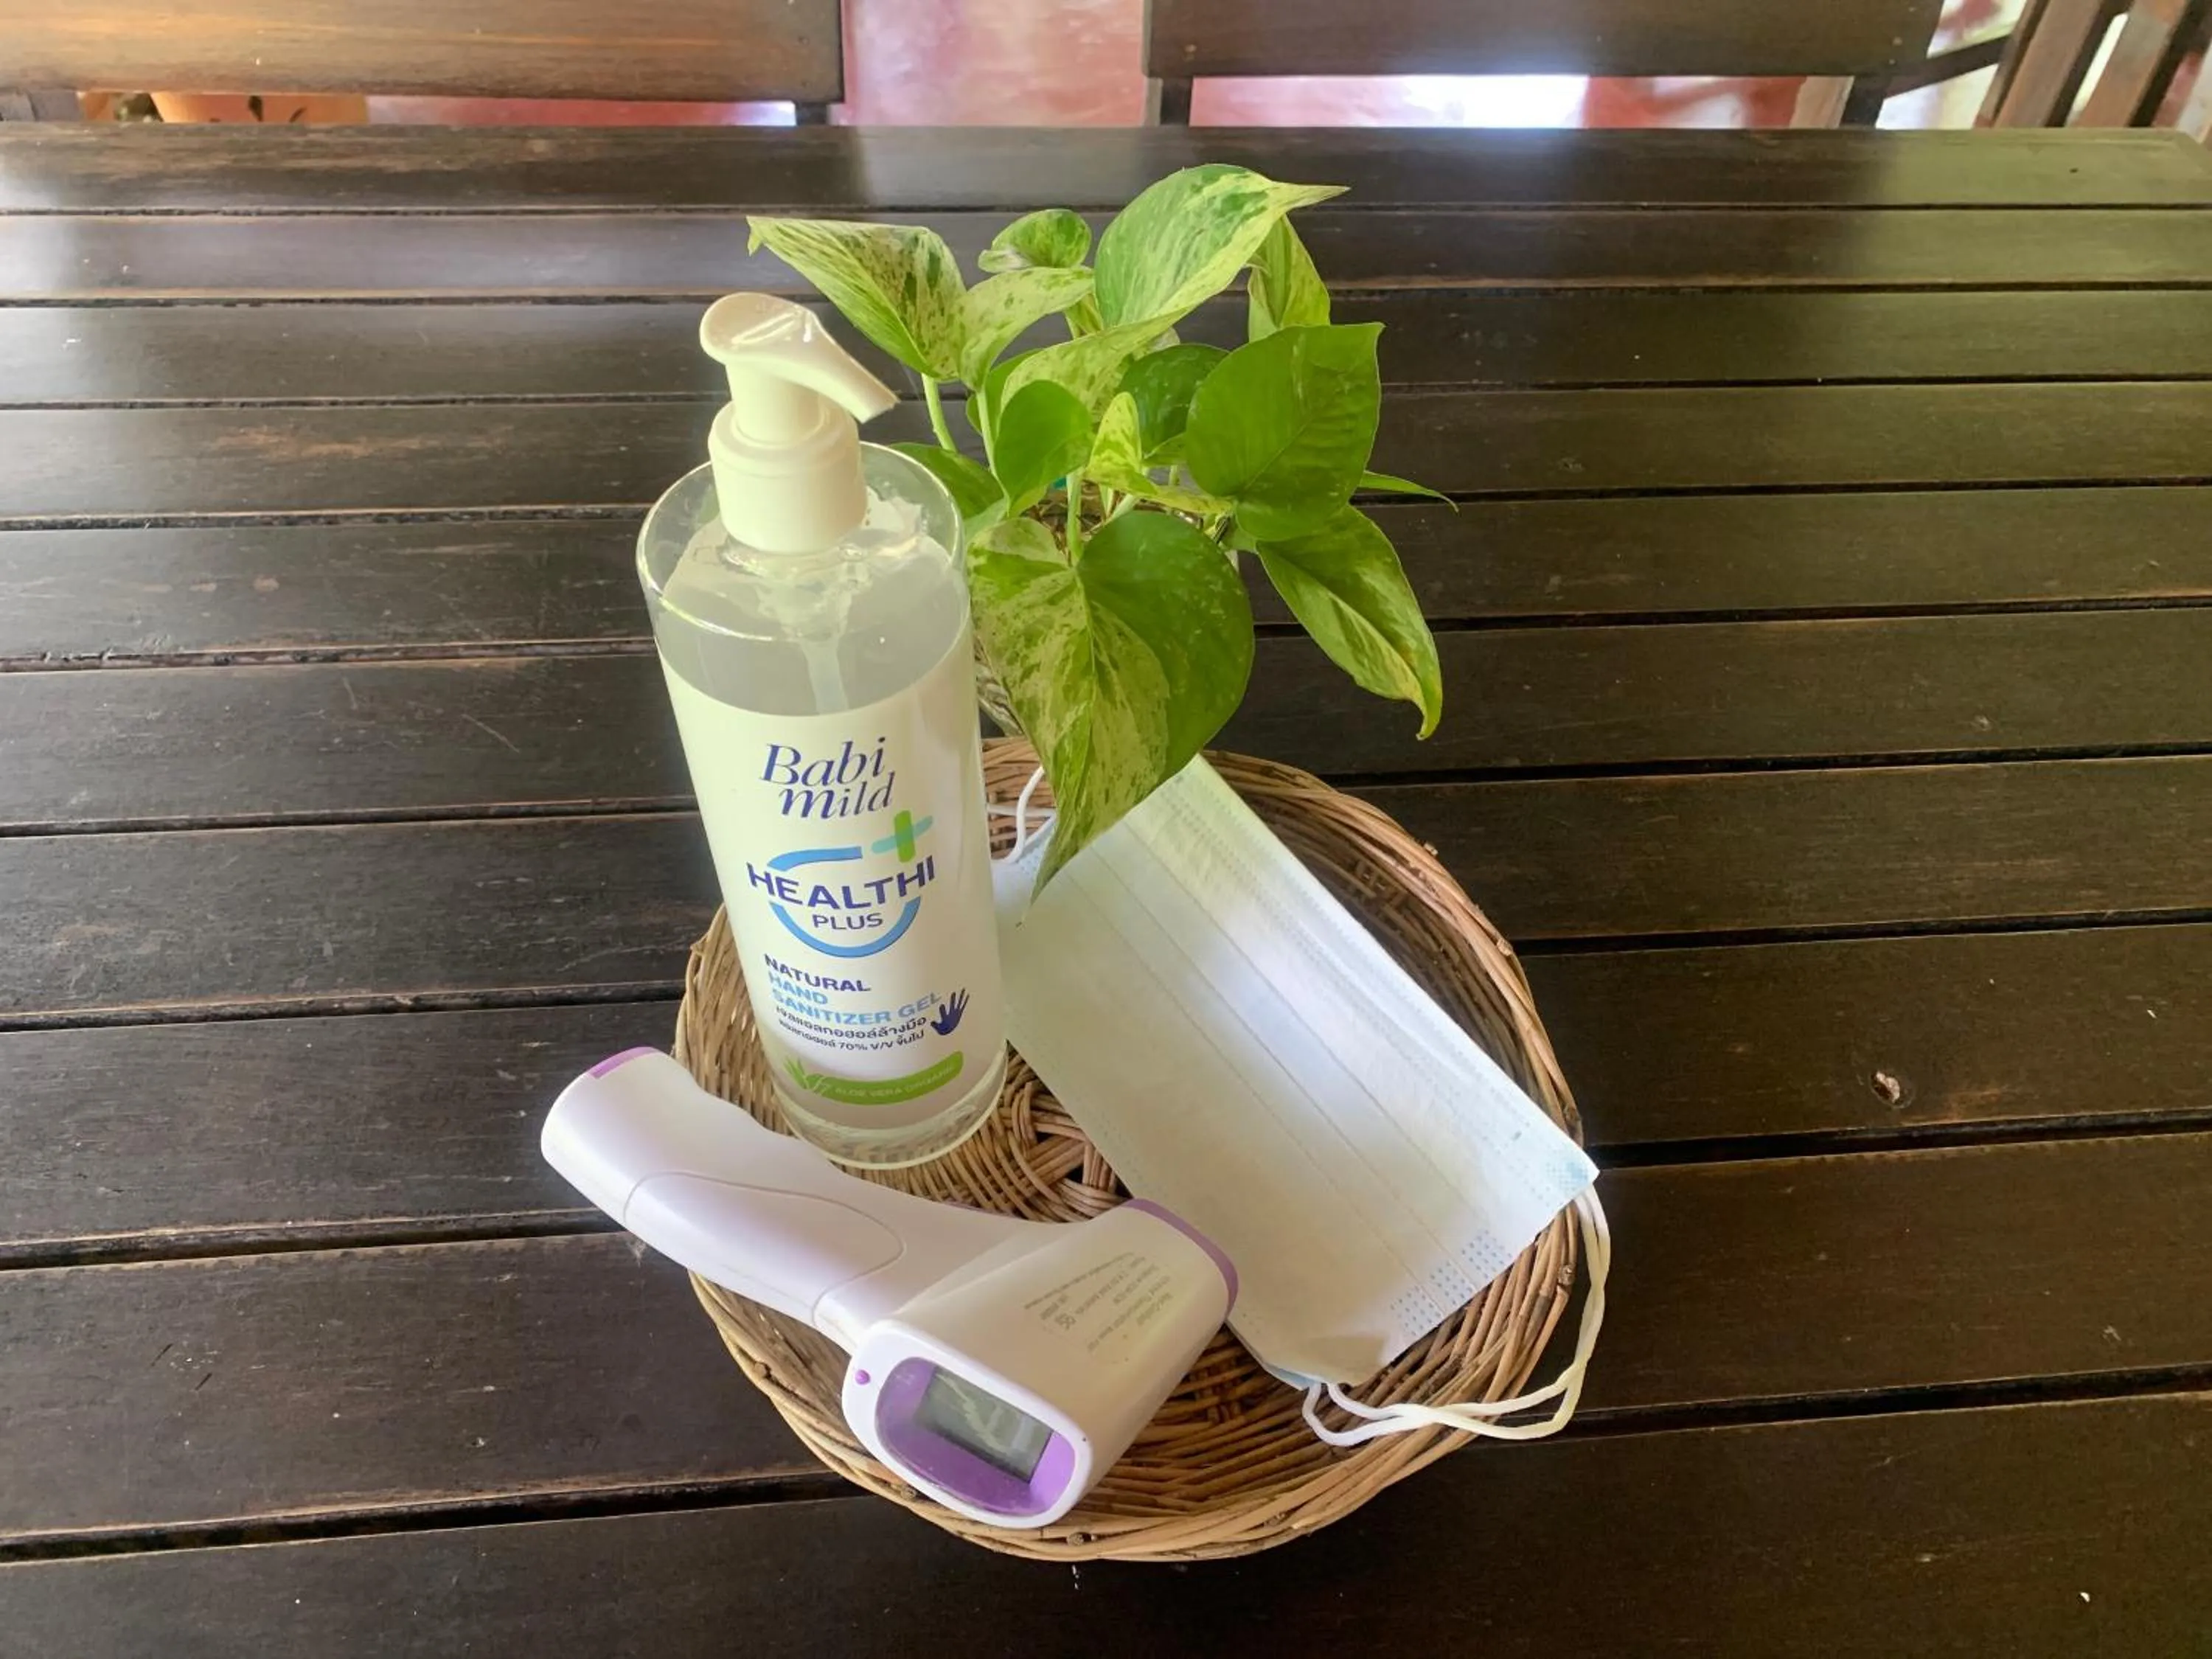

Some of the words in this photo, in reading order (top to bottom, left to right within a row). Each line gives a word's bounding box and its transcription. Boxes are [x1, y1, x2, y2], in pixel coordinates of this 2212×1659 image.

[759, 737, 886, 787] Babi
[779, 771, 896, 819] mild
[745, 855, 936, 910] HEALTHI
[812, 912, 884, 930] PLUS
[764, 953, 872, 992] NATURAL
[768, 970, 828, 1005] HAND
[772, 988, 891, 1025] SANITIZER
[897, 992, 942, 1018] GEL
[838, 1041, 868, 1051] 70%
